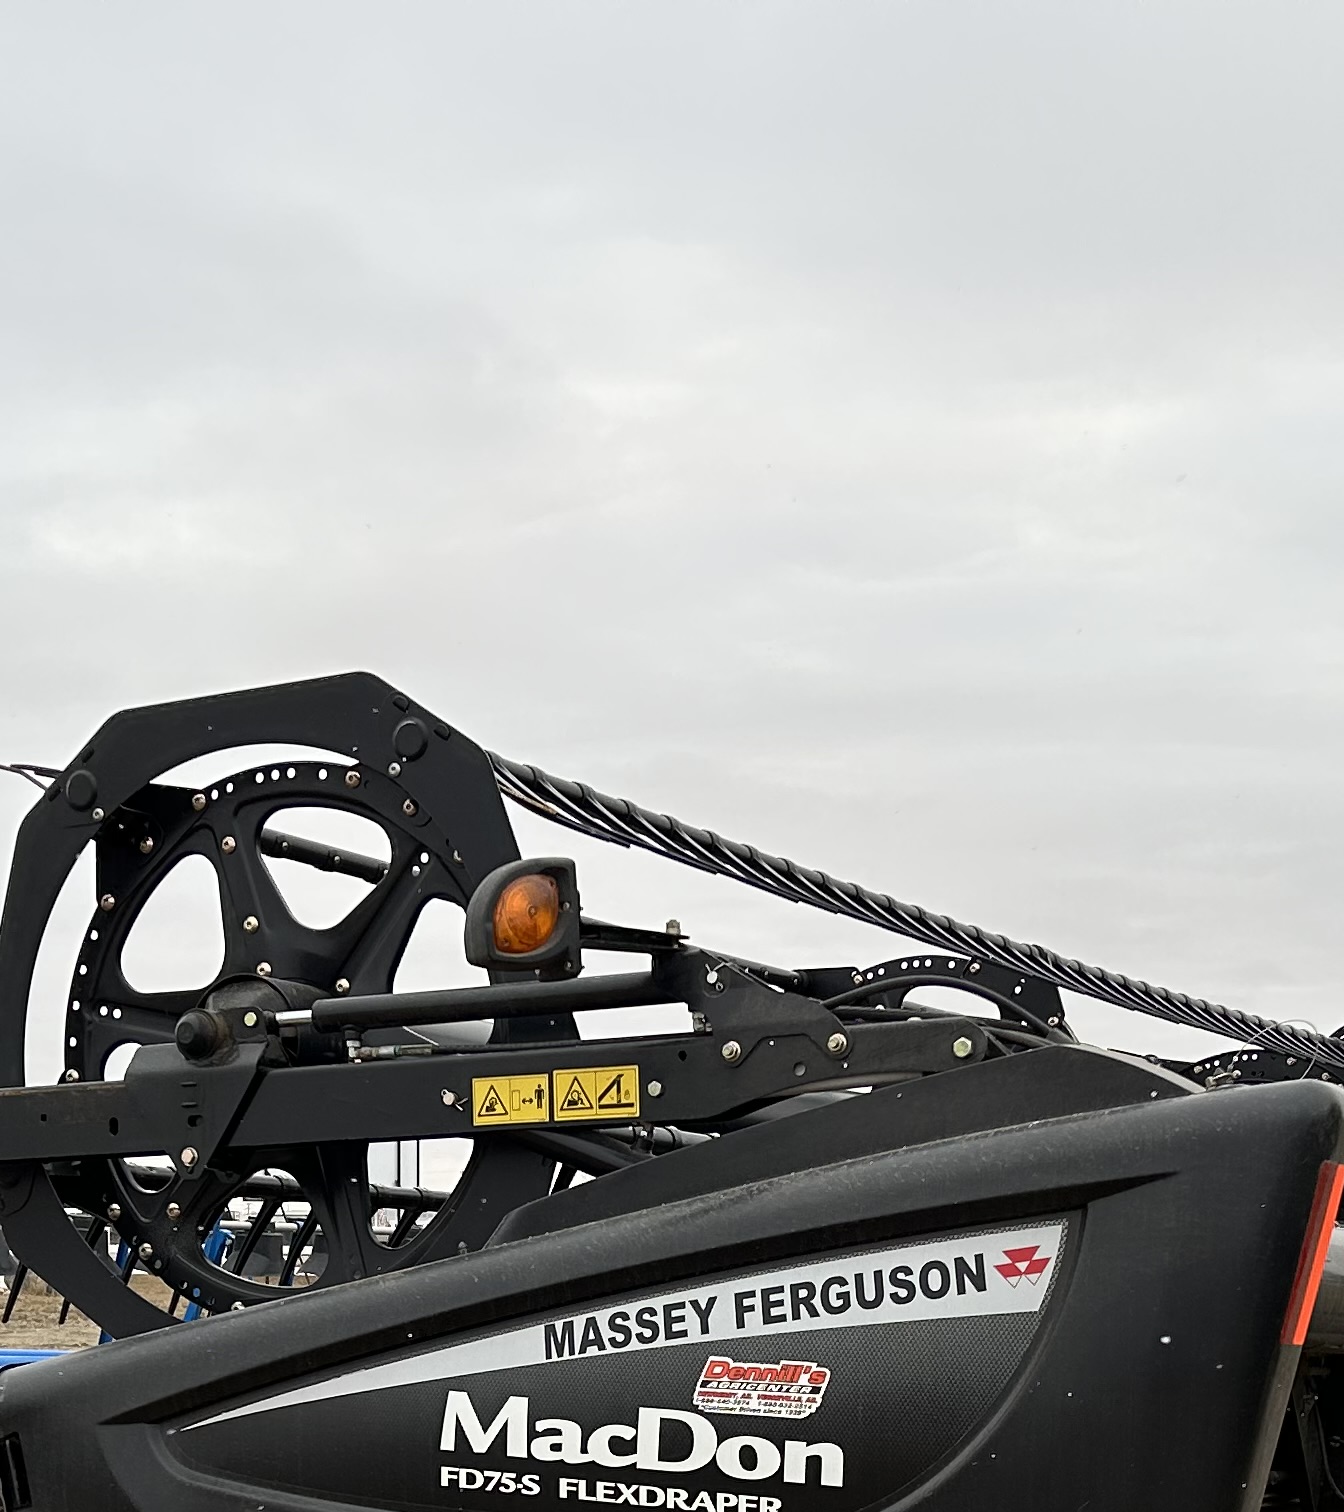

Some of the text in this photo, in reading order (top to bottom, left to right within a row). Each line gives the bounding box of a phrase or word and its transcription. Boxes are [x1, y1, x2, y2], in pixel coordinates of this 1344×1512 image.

[544, 1253, 987, 1359] MASSEY FERGUSON
[704, 1361, 827, 1385] Dennill's
[706, 1381, 813, 1394] AGRICENTER
[439, 1390, 844, 1487] MacDon
[440, 1466, 541, 1496] FD75-S
